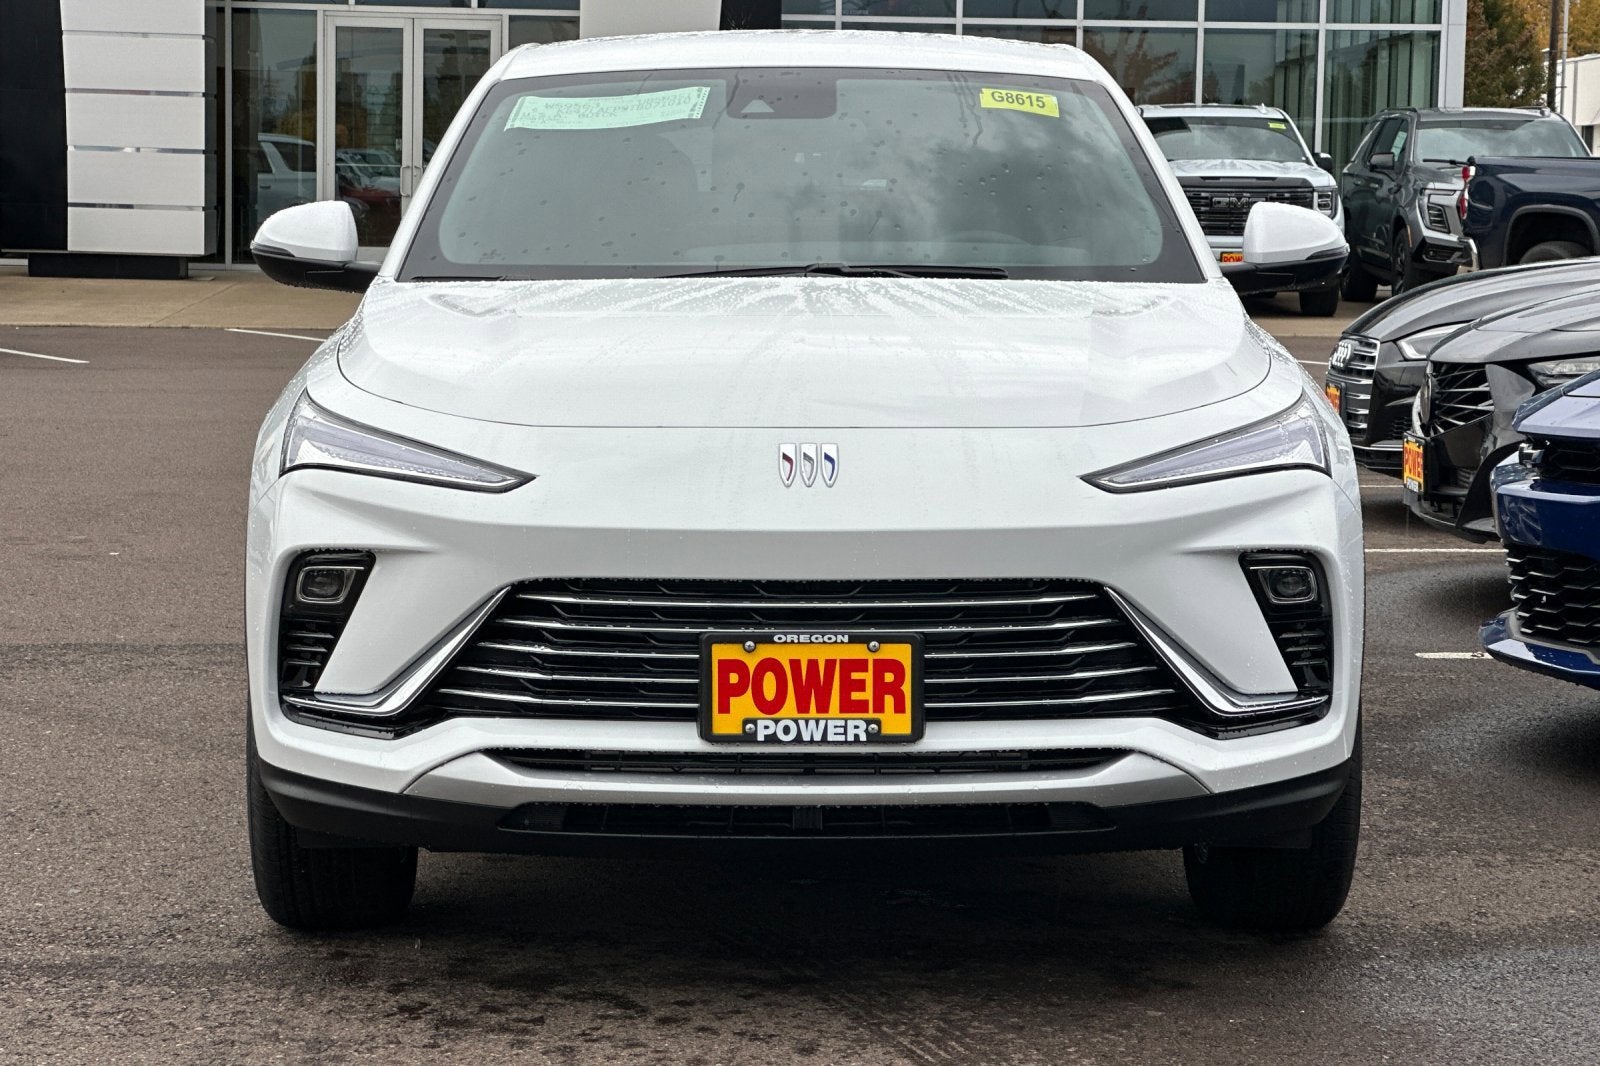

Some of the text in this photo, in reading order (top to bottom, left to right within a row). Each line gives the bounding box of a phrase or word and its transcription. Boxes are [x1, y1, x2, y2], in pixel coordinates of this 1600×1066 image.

[991, 91, 1046, 108] G8615
[773, 634, 849, 643] OREGON
[717, 657, 906, 715] POWER
[756, 719, 867, 741] POWER
